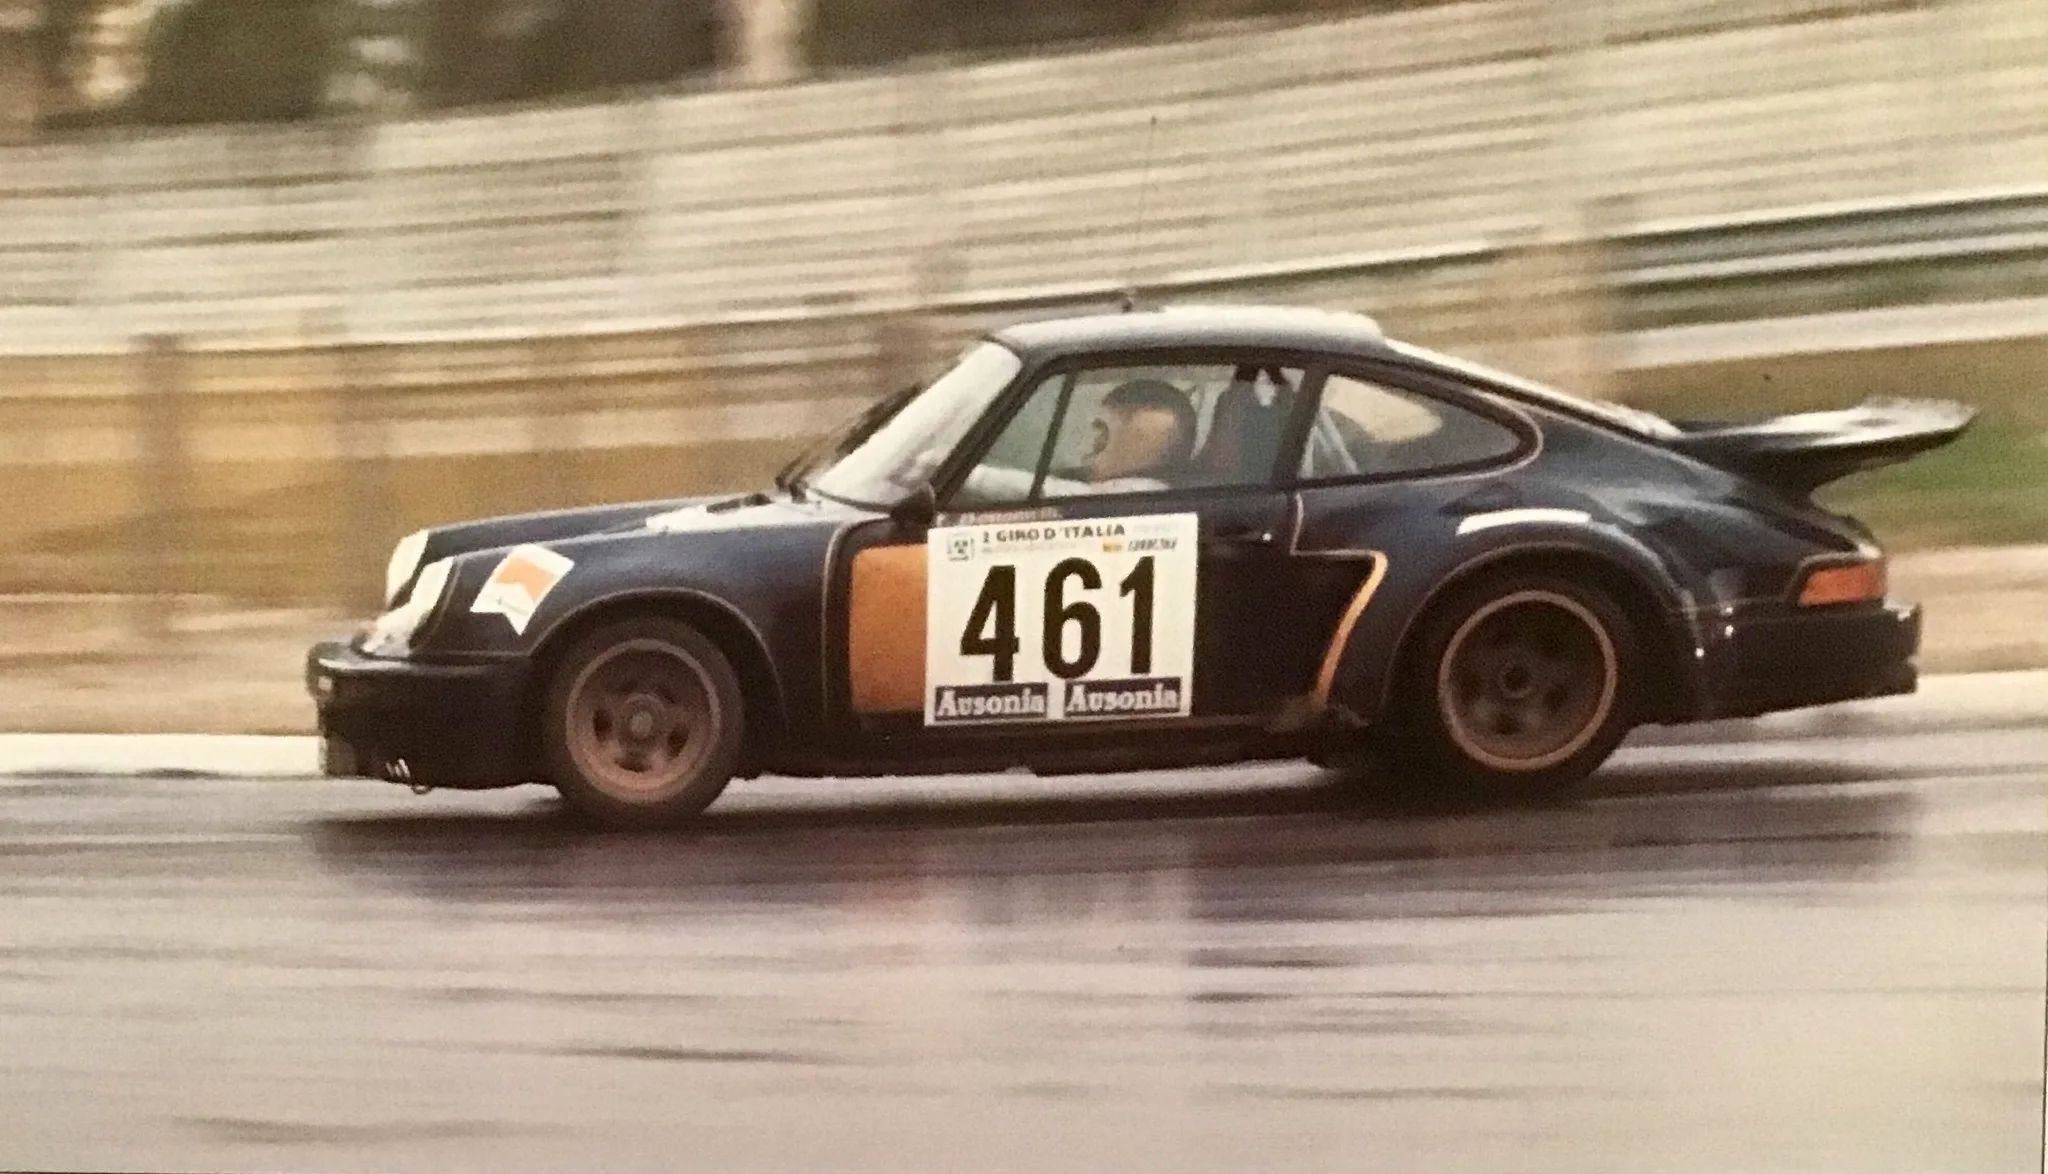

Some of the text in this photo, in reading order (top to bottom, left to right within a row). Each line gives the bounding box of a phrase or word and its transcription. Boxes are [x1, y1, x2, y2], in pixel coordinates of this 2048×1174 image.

[995, 528, 1040, 543] GIRO
[959, 556, 1155, 682] 461
[936, 687, 1045, 716] Ausonia
[1065, 682, 1177, 711] Ausonia
